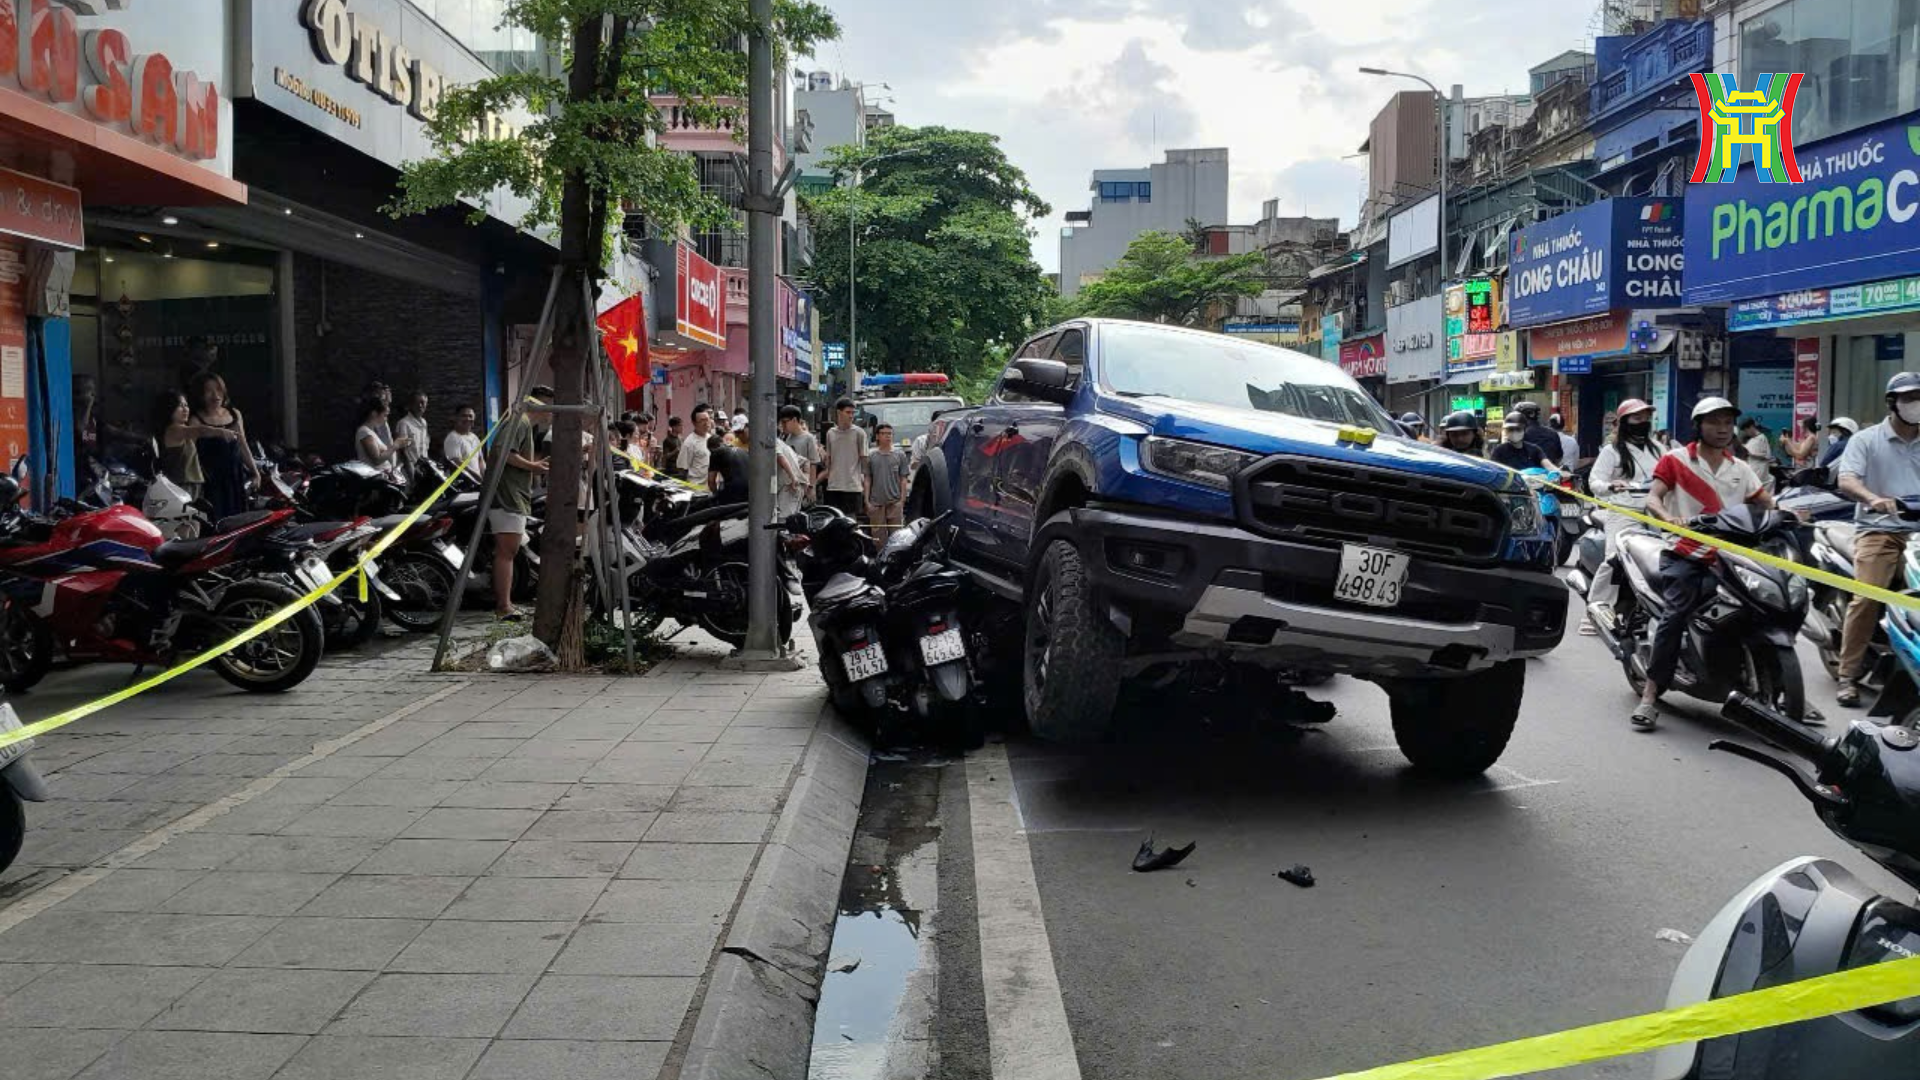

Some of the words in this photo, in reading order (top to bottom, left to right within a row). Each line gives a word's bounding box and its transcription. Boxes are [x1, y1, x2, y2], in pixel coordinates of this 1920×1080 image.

[1790, 155, 1824, 185] HÀ
[1825, 138, 1885, 176] THUỐC
[1532, 237, 1551, 261] NHÀ
[1551, 224, 1583, 256] THUỐC
[1627, 238, 1650, 249] NHÀ
[1514, 263, 1552, 300] LONG
[1556, 247, 1603, 288] CHÂU
[1626, 253, 1685, 272] LONG
[1254, 481, 1497, 538] FORD
[1358, 549, 1396, 576] 30F
[1337, 575, 1398, 604] 498.43
